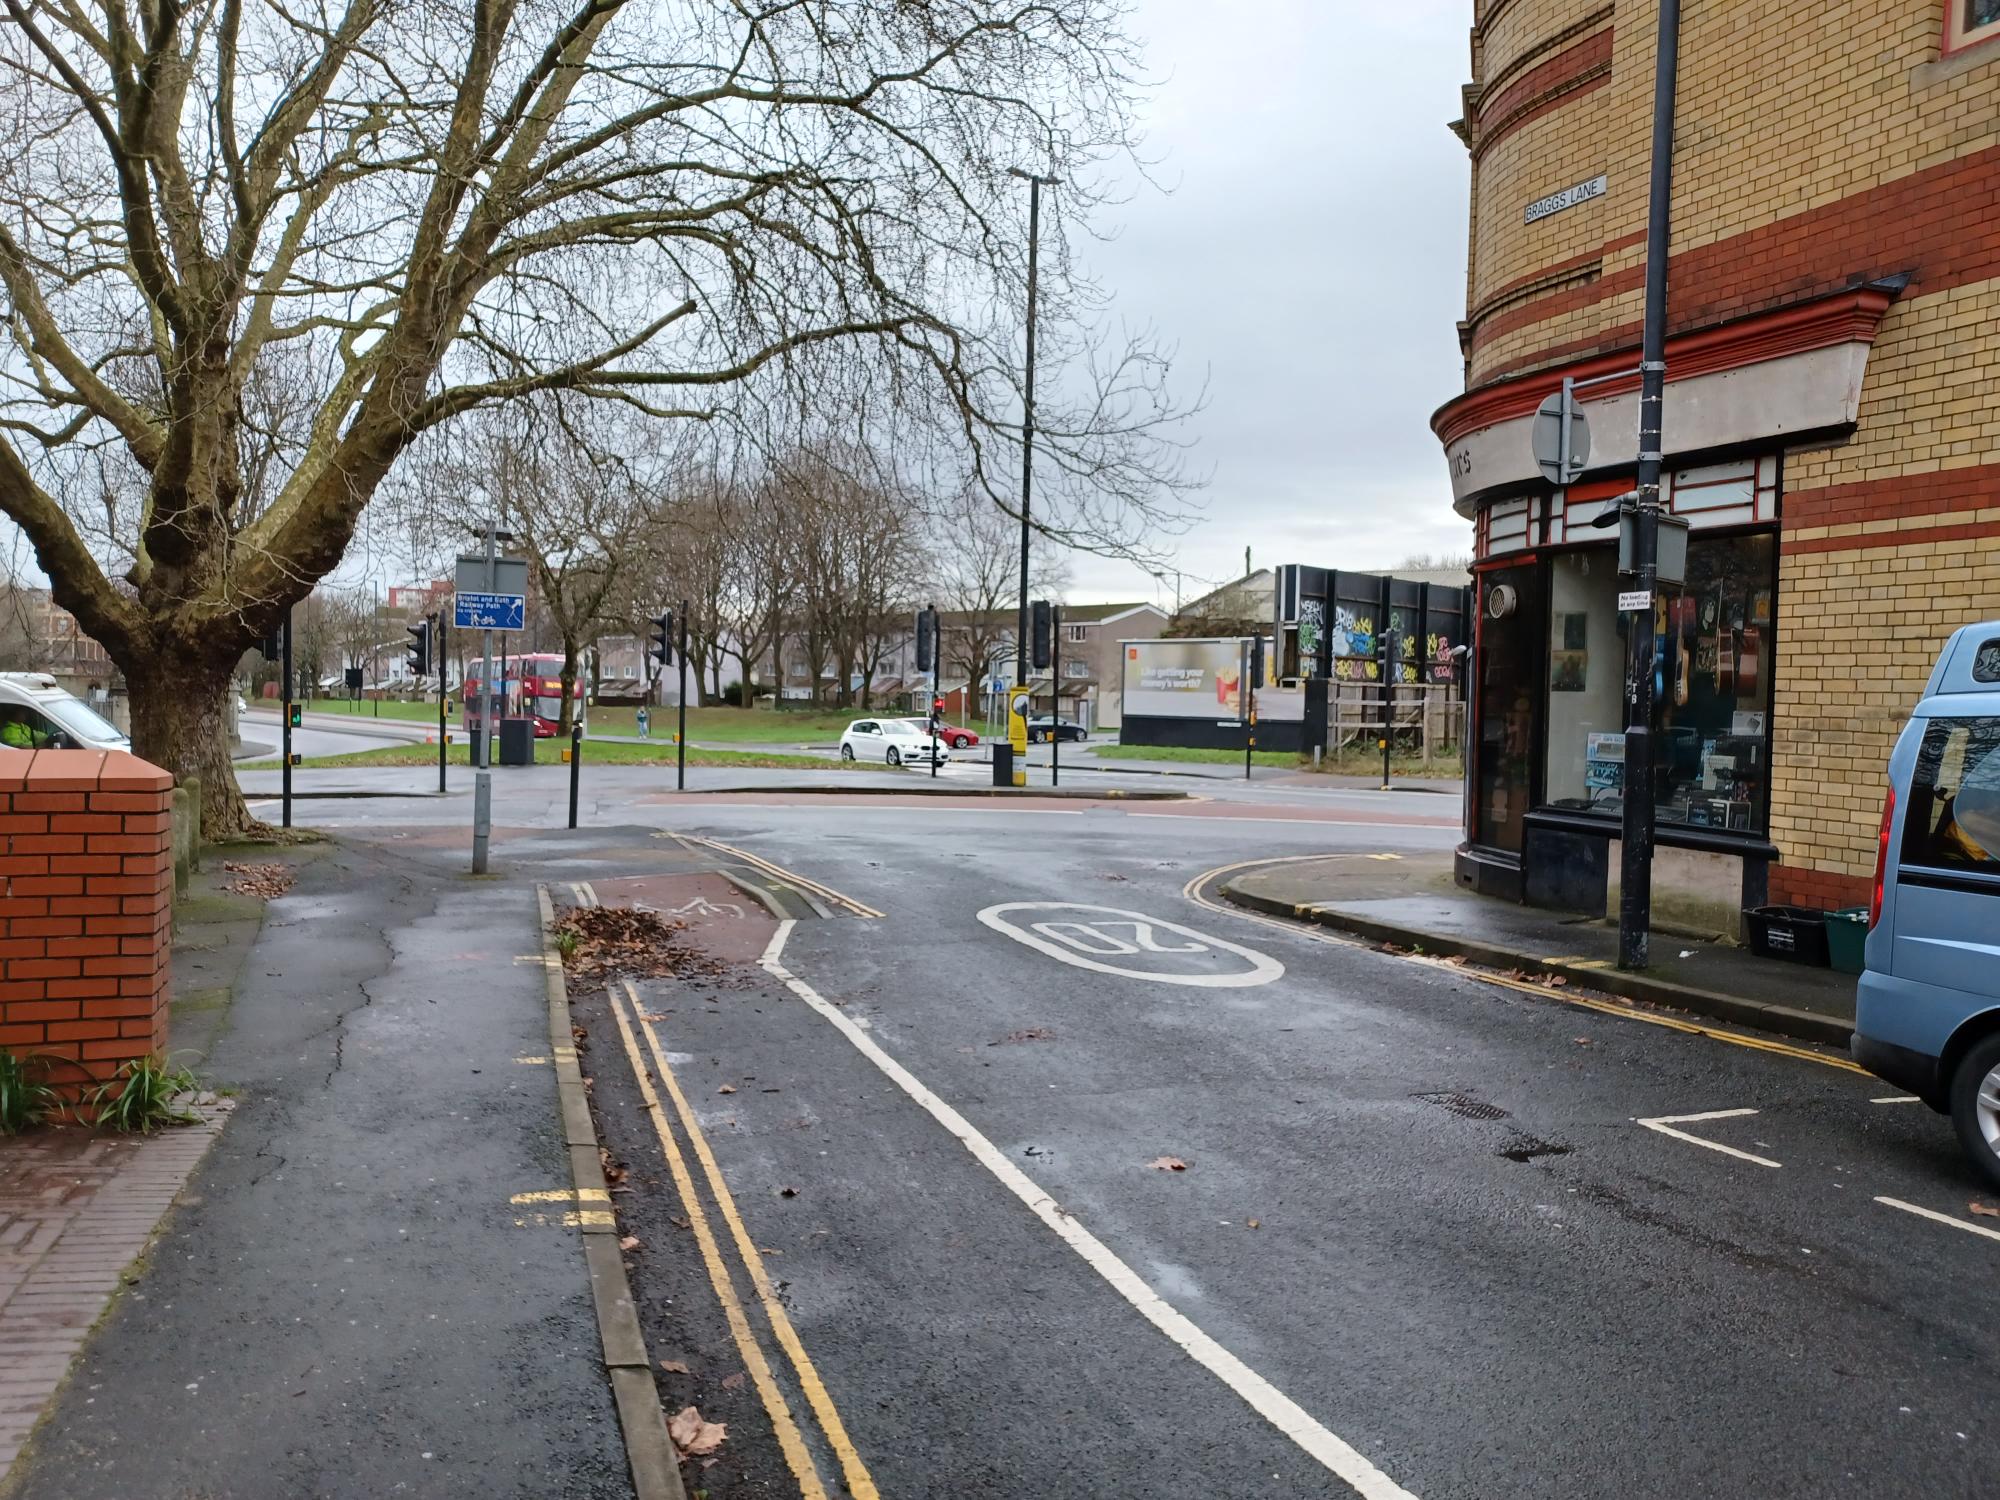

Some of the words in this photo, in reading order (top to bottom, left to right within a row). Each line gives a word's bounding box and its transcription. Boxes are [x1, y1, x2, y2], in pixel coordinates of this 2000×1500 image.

[1526, 193, 1566, 221] BRAGGS
[1571, 180, 1598, 203] LANE
[459, 601, 485, 609] Railway
[1156, 667, 1186, 679] getting
[1186, 668, 1204, 680] your
[1172, 679, 1201, 689] worth?
